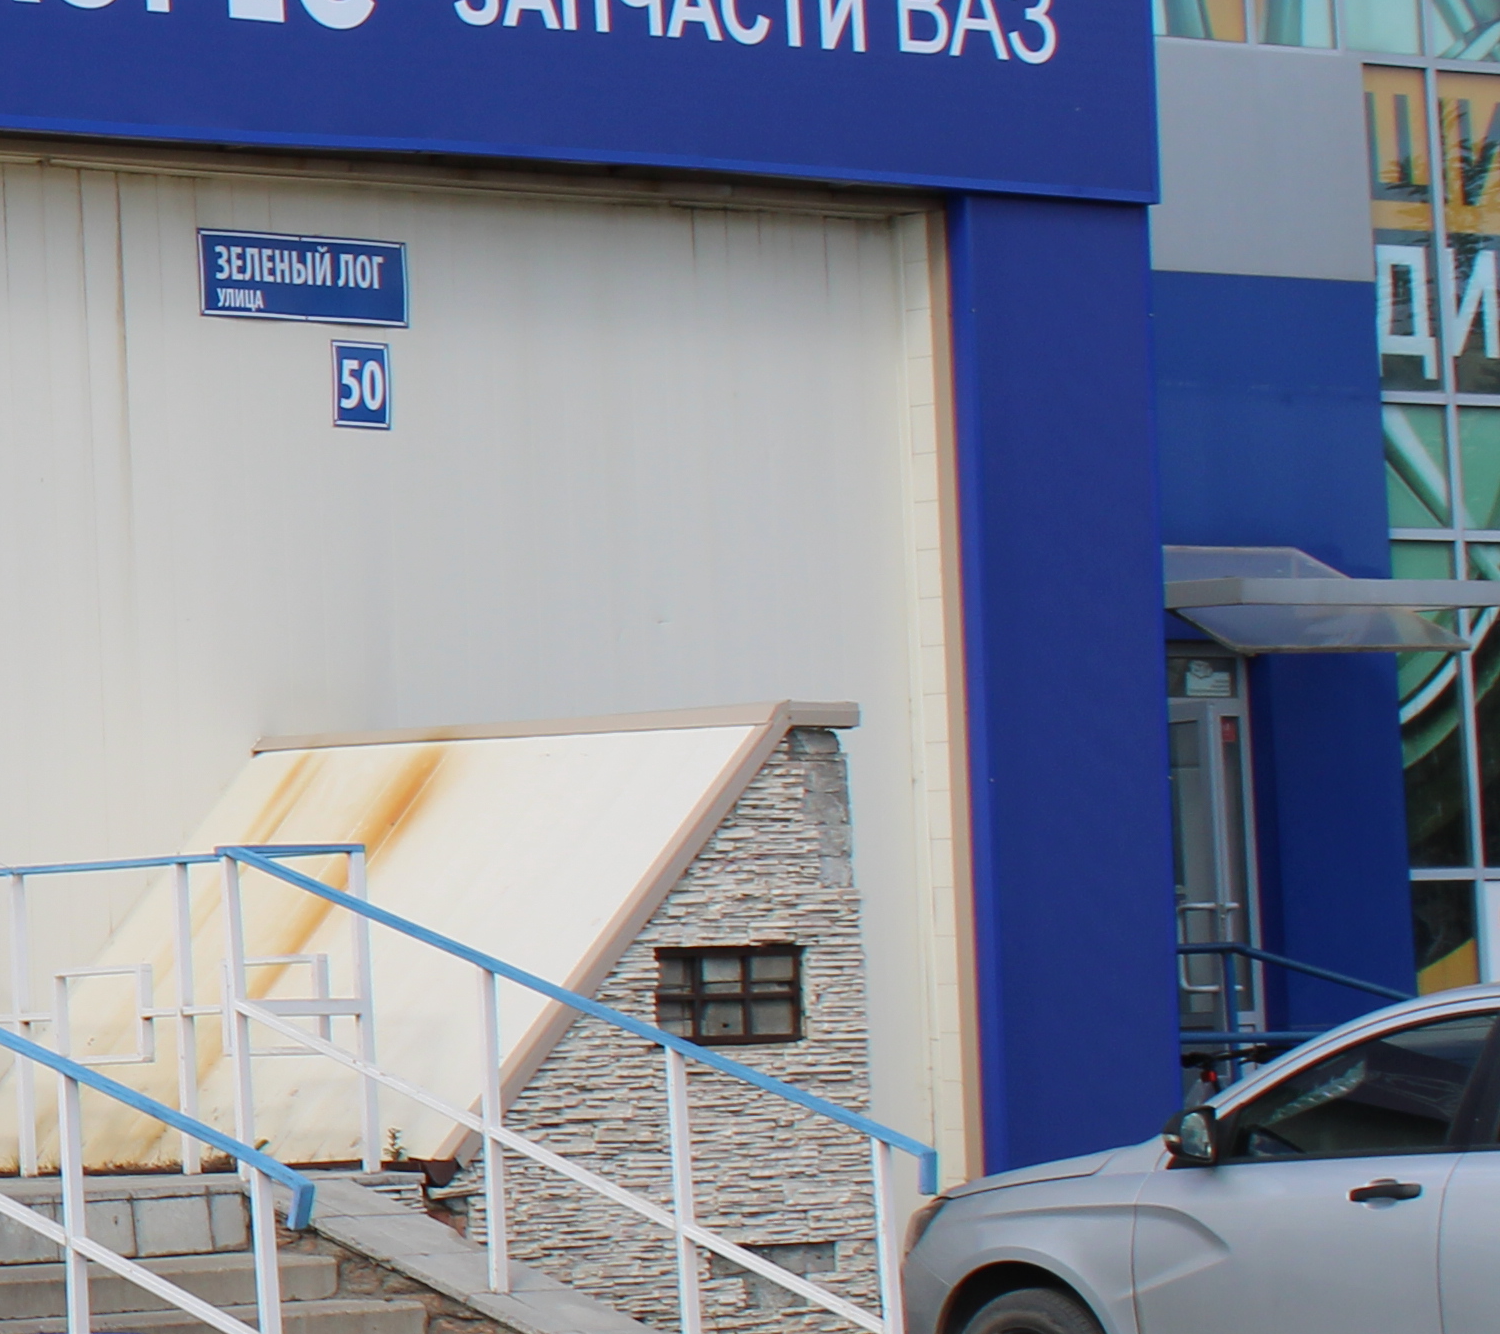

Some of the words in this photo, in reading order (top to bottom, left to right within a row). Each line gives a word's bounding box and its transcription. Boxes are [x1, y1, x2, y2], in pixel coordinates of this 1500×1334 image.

[213, 245, 333, 287] ЗЕЛЕНЫЙ
[337, 253, 385, 290] ЛОГ
[216, 287, 265, 312] УЛИЦА
[339, 358, 385, 412] 50
